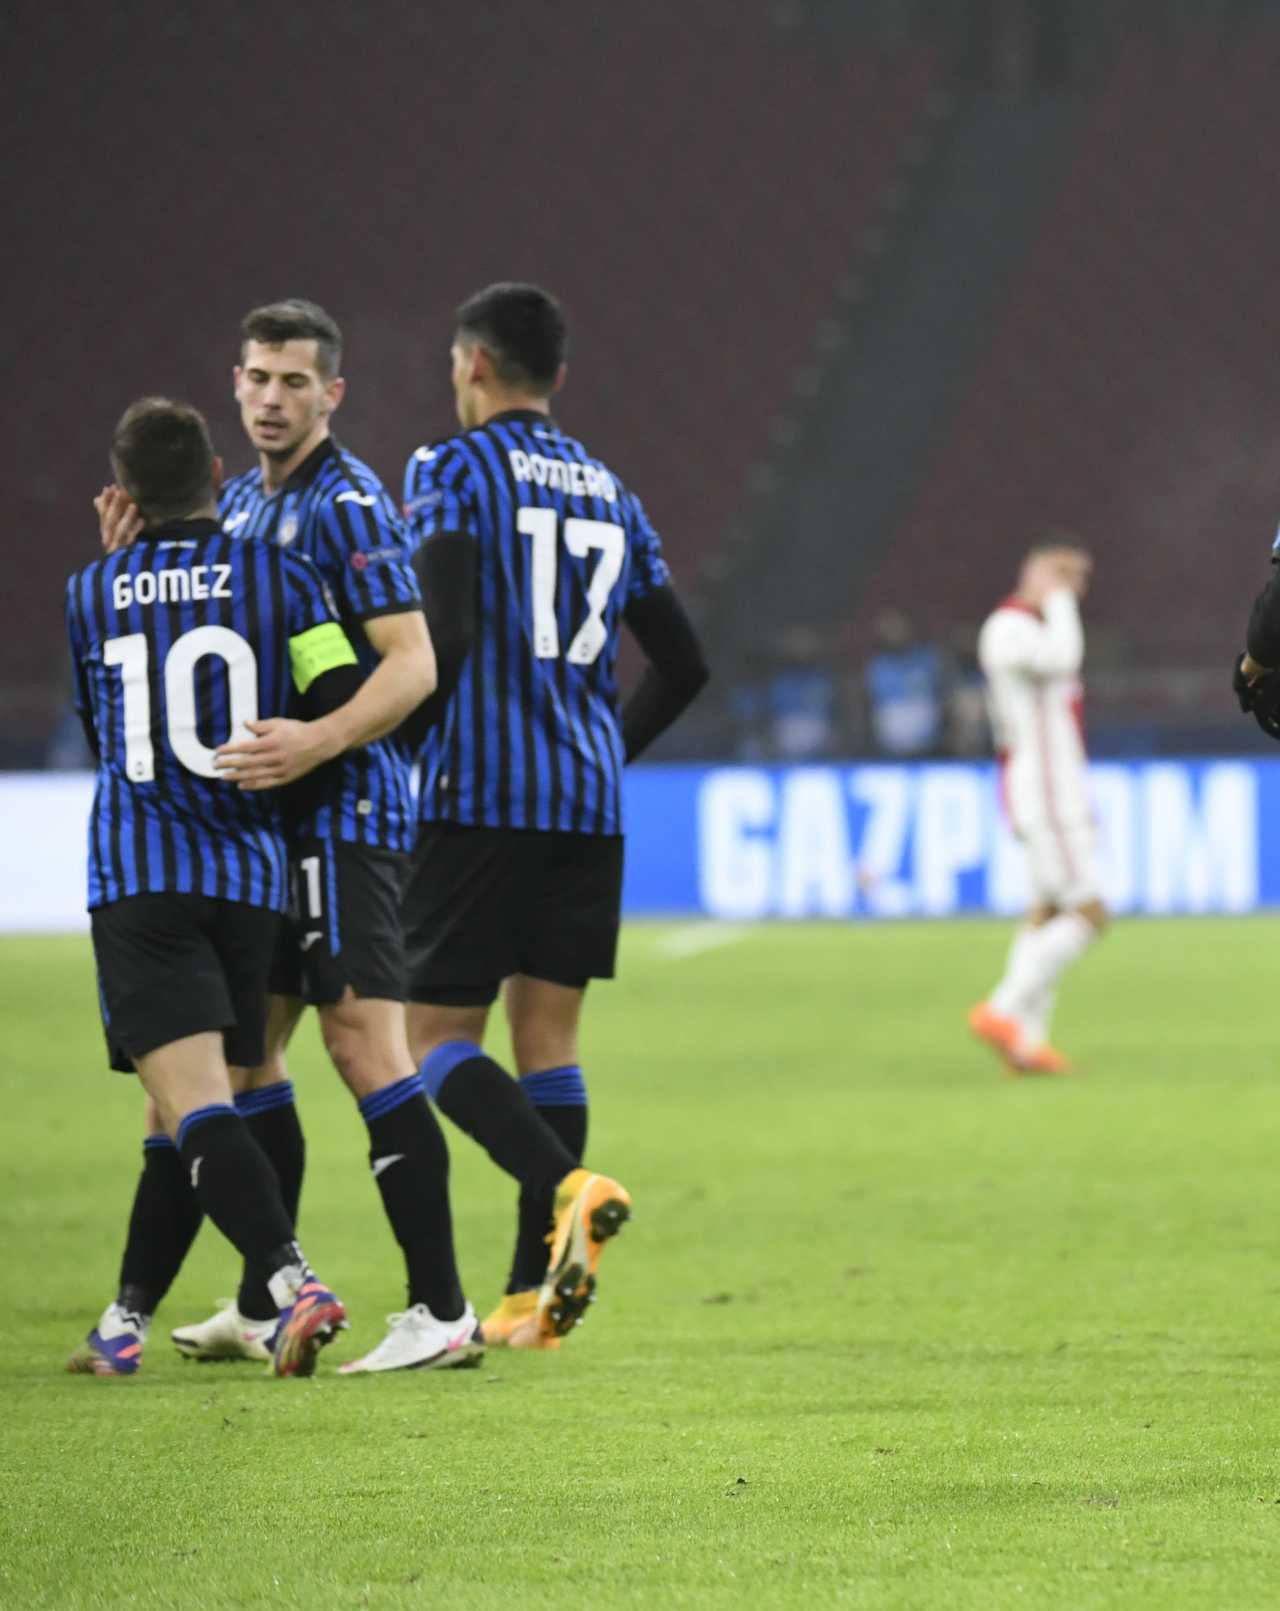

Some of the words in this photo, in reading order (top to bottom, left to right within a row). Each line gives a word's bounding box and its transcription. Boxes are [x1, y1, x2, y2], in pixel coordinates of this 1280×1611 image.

[113, 564, 232, 610] GOMEZ
[517, 507, 625, 664] 17
[103, 625, 258, 783] 10
